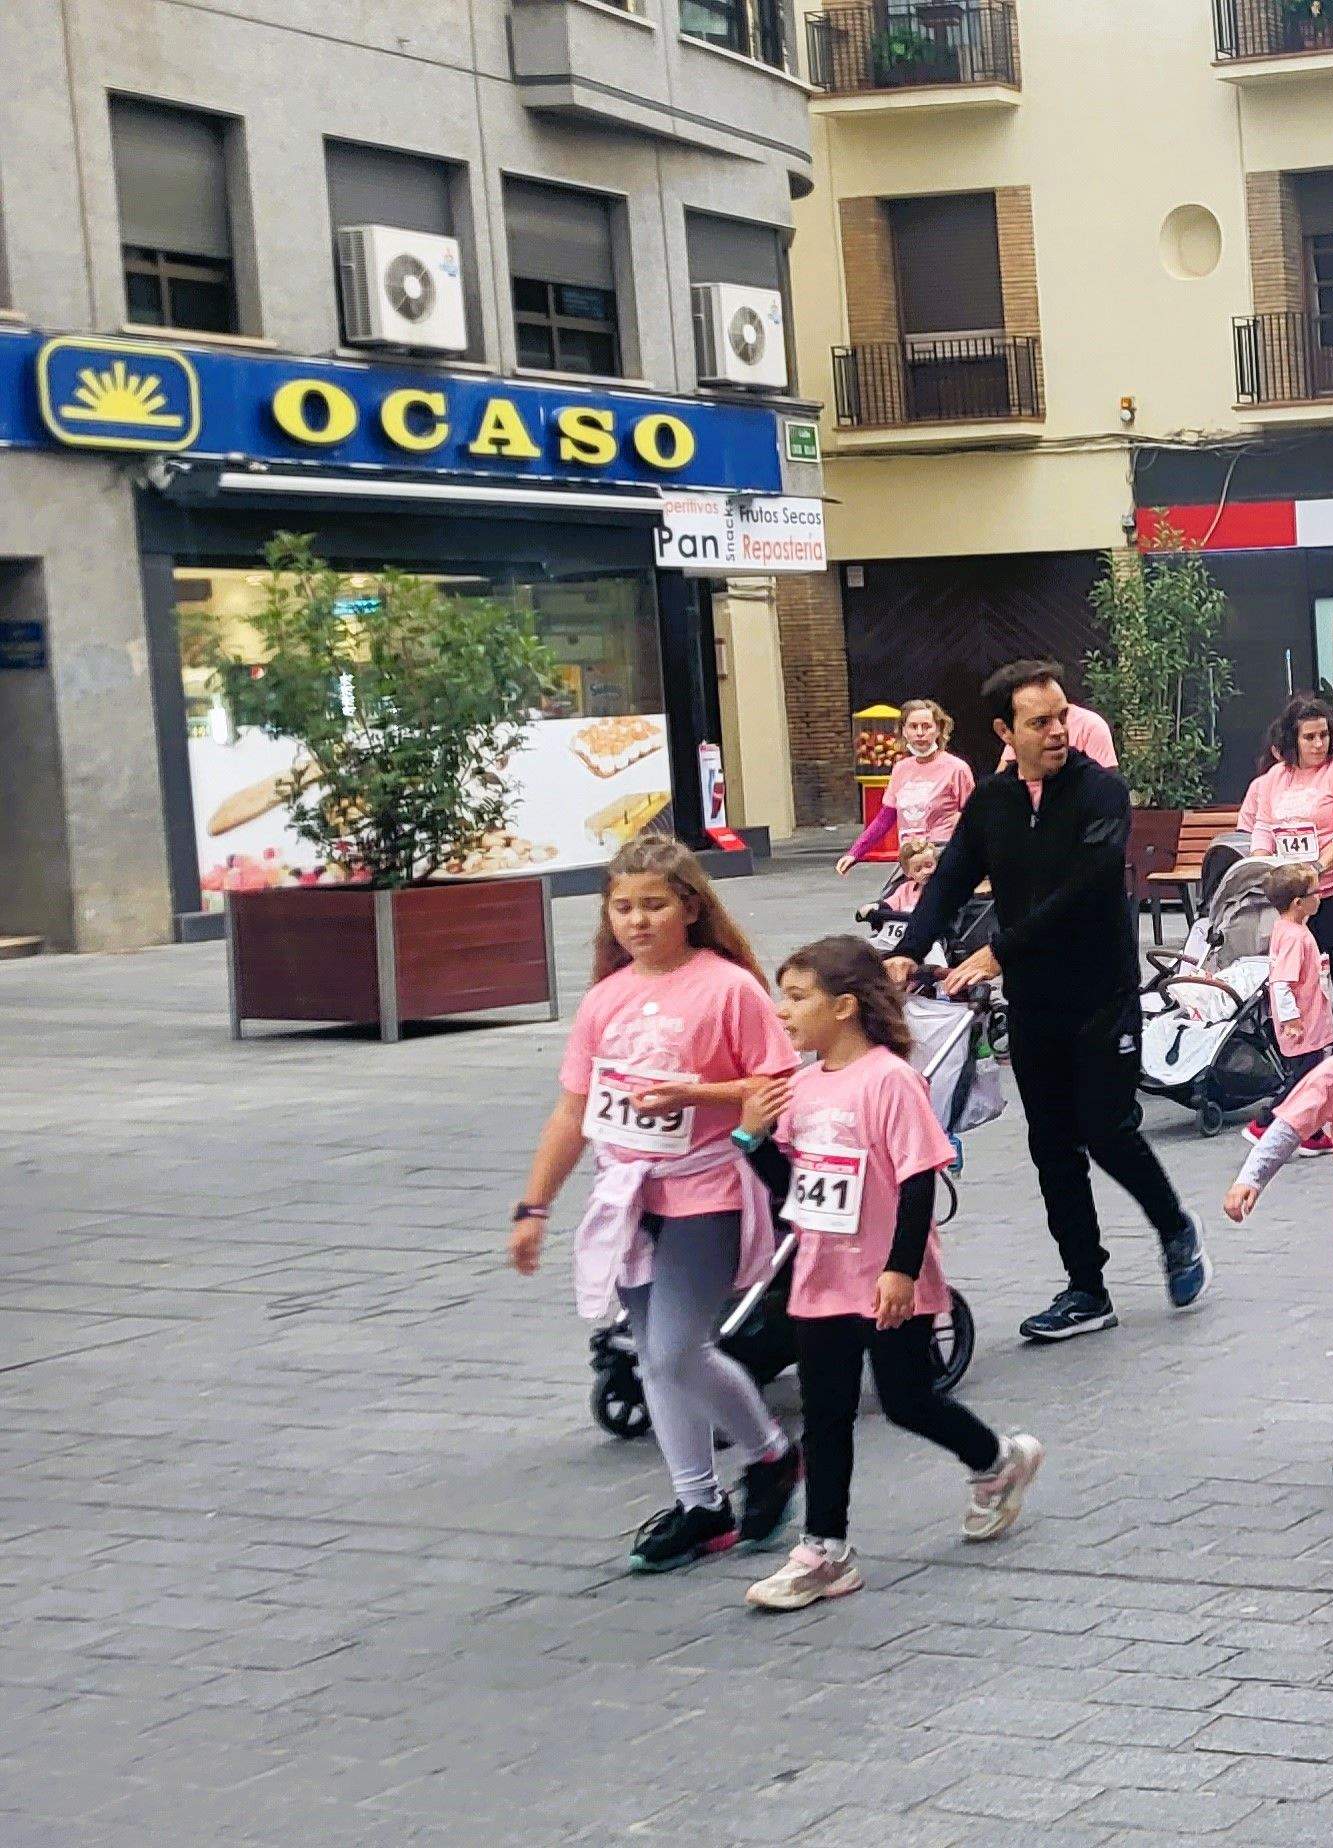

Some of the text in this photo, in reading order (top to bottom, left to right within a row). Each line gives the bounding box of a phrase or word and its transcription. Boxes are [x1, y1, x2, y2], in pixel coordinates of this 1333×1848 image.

[273, 379, 695, 469] OCASO
[665, 500, 719, 517] peritivos
[782, 507, 822, 525] Secos
[657, 524, 720, 559] Pan
[1282, 836, 1309, 852] 141
